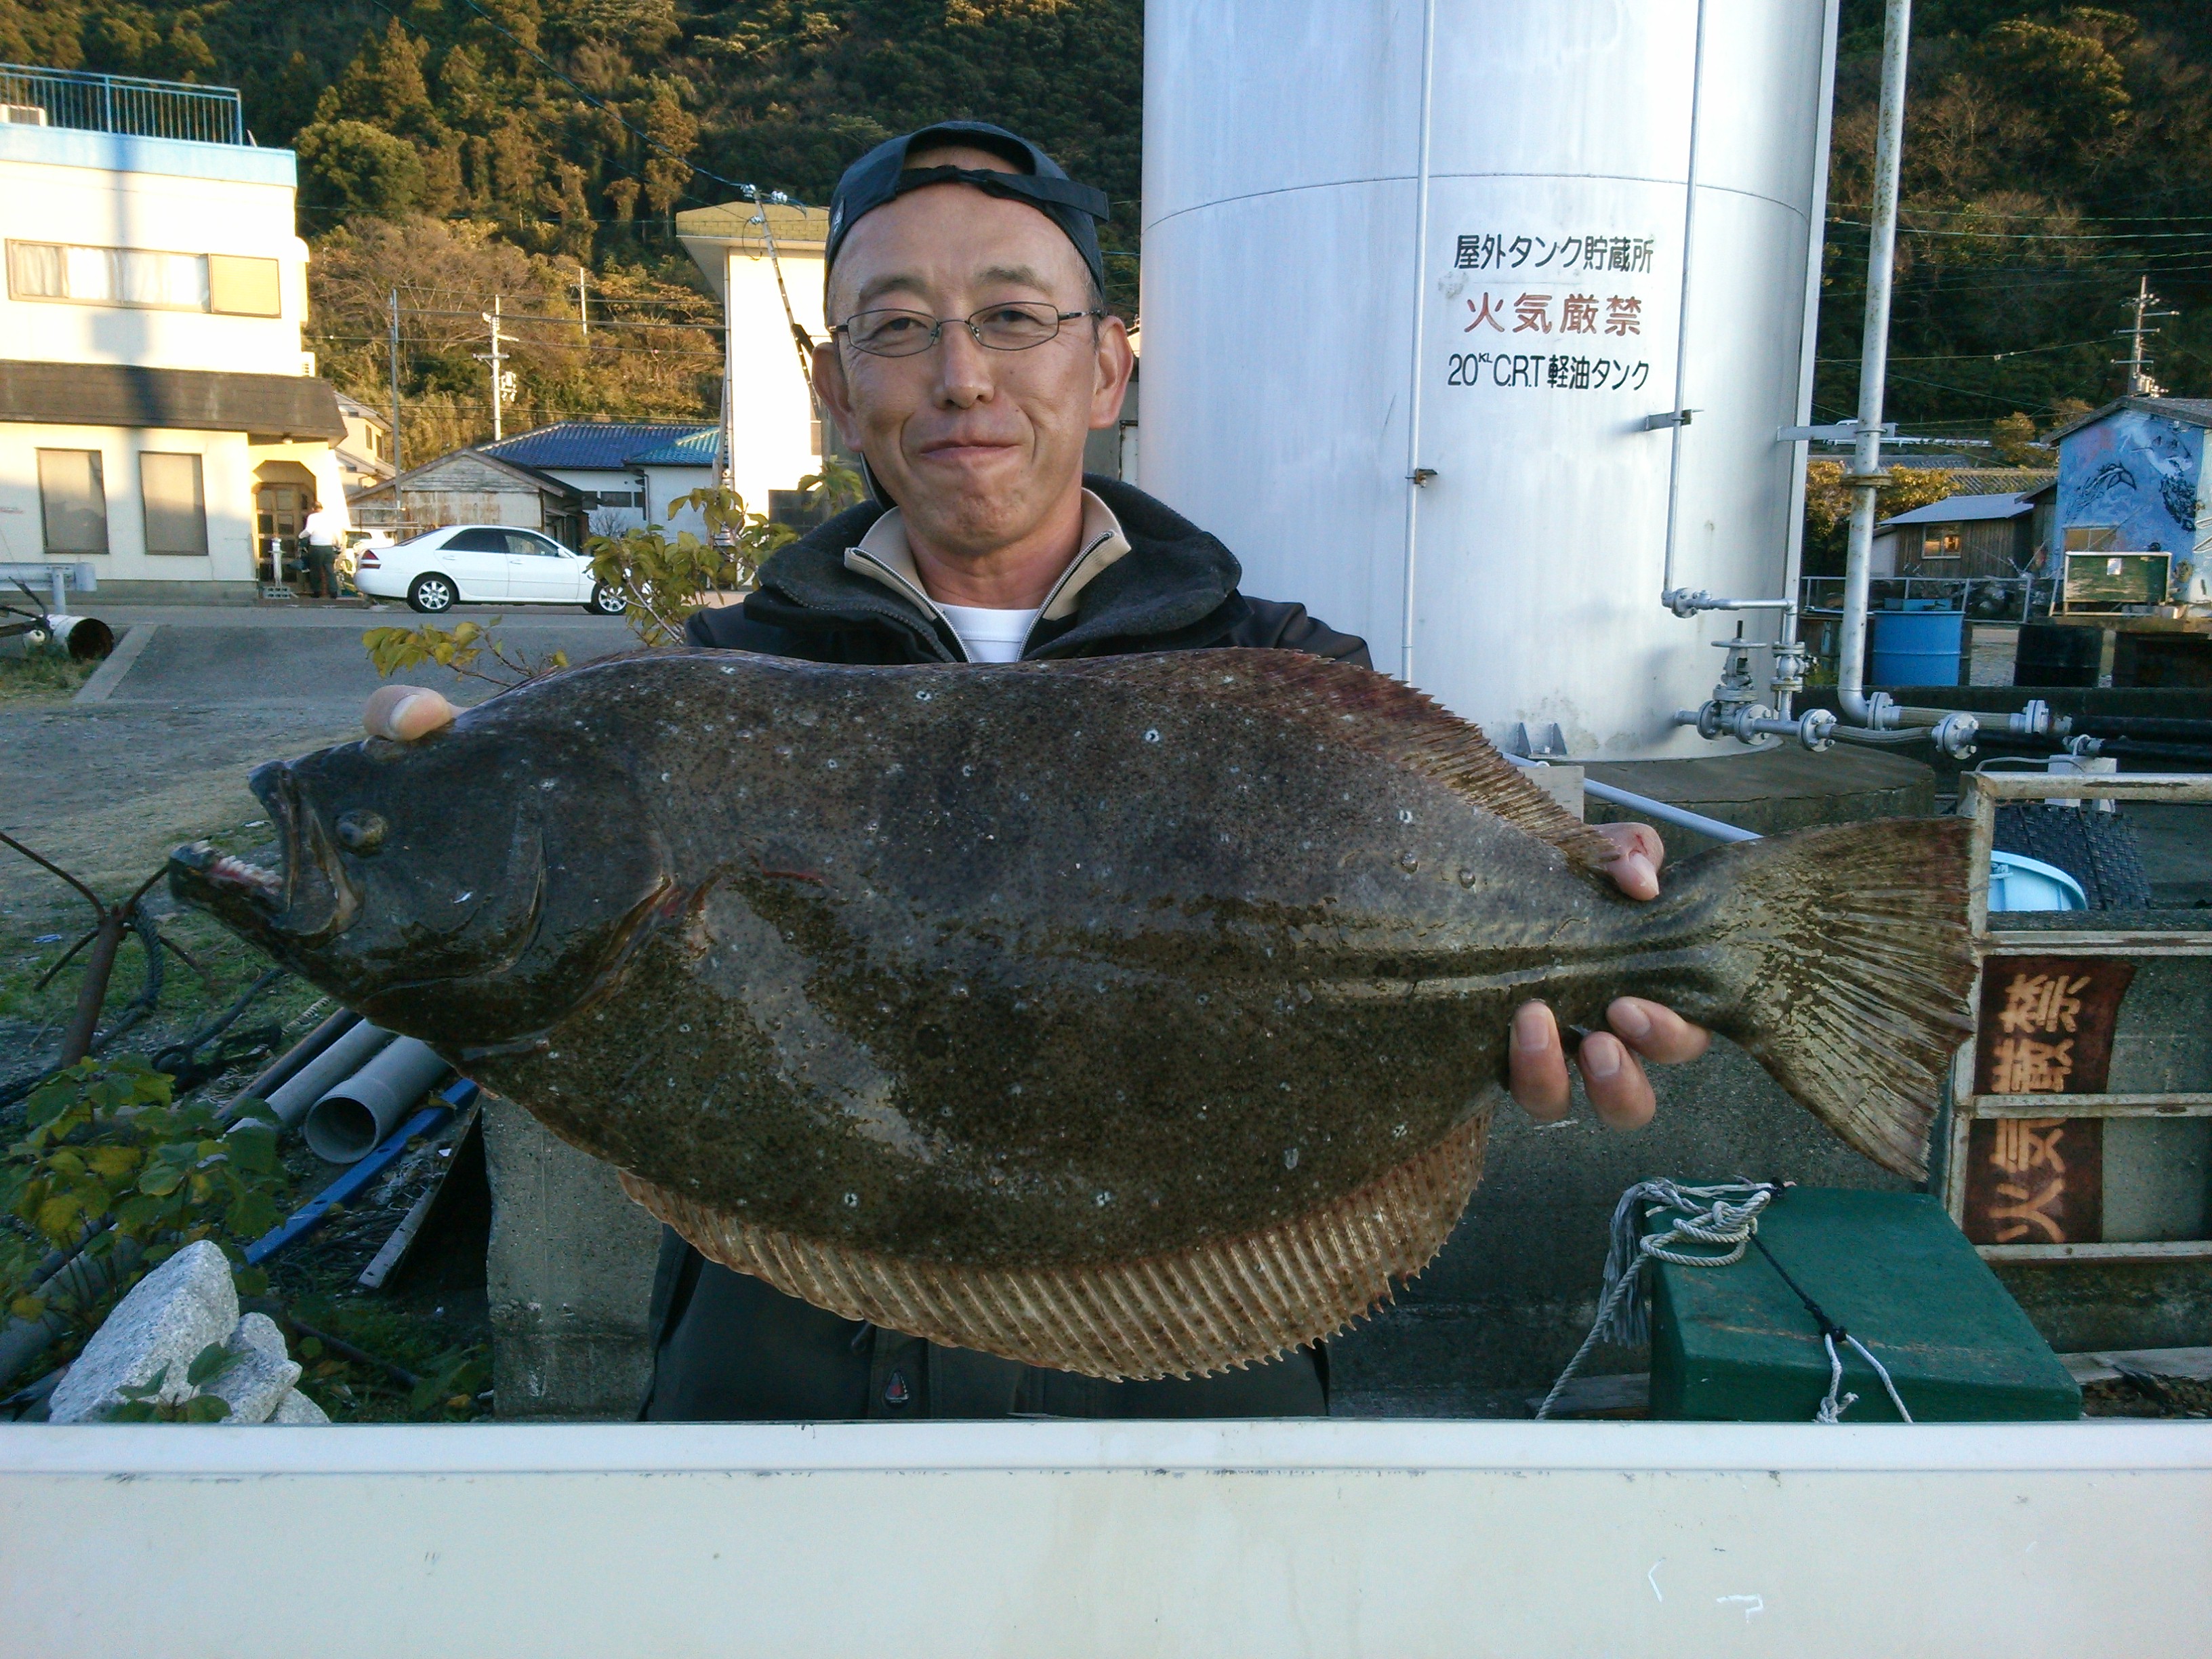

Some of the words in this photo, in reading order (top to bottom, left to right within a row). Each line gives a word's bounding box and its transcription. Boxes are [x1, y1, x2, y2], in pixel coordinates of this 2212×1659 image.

[1454, 234, 1655, 273] 屋外タンク貯蔵所
[1464, 292, 1642, 336] 火気厳禁
